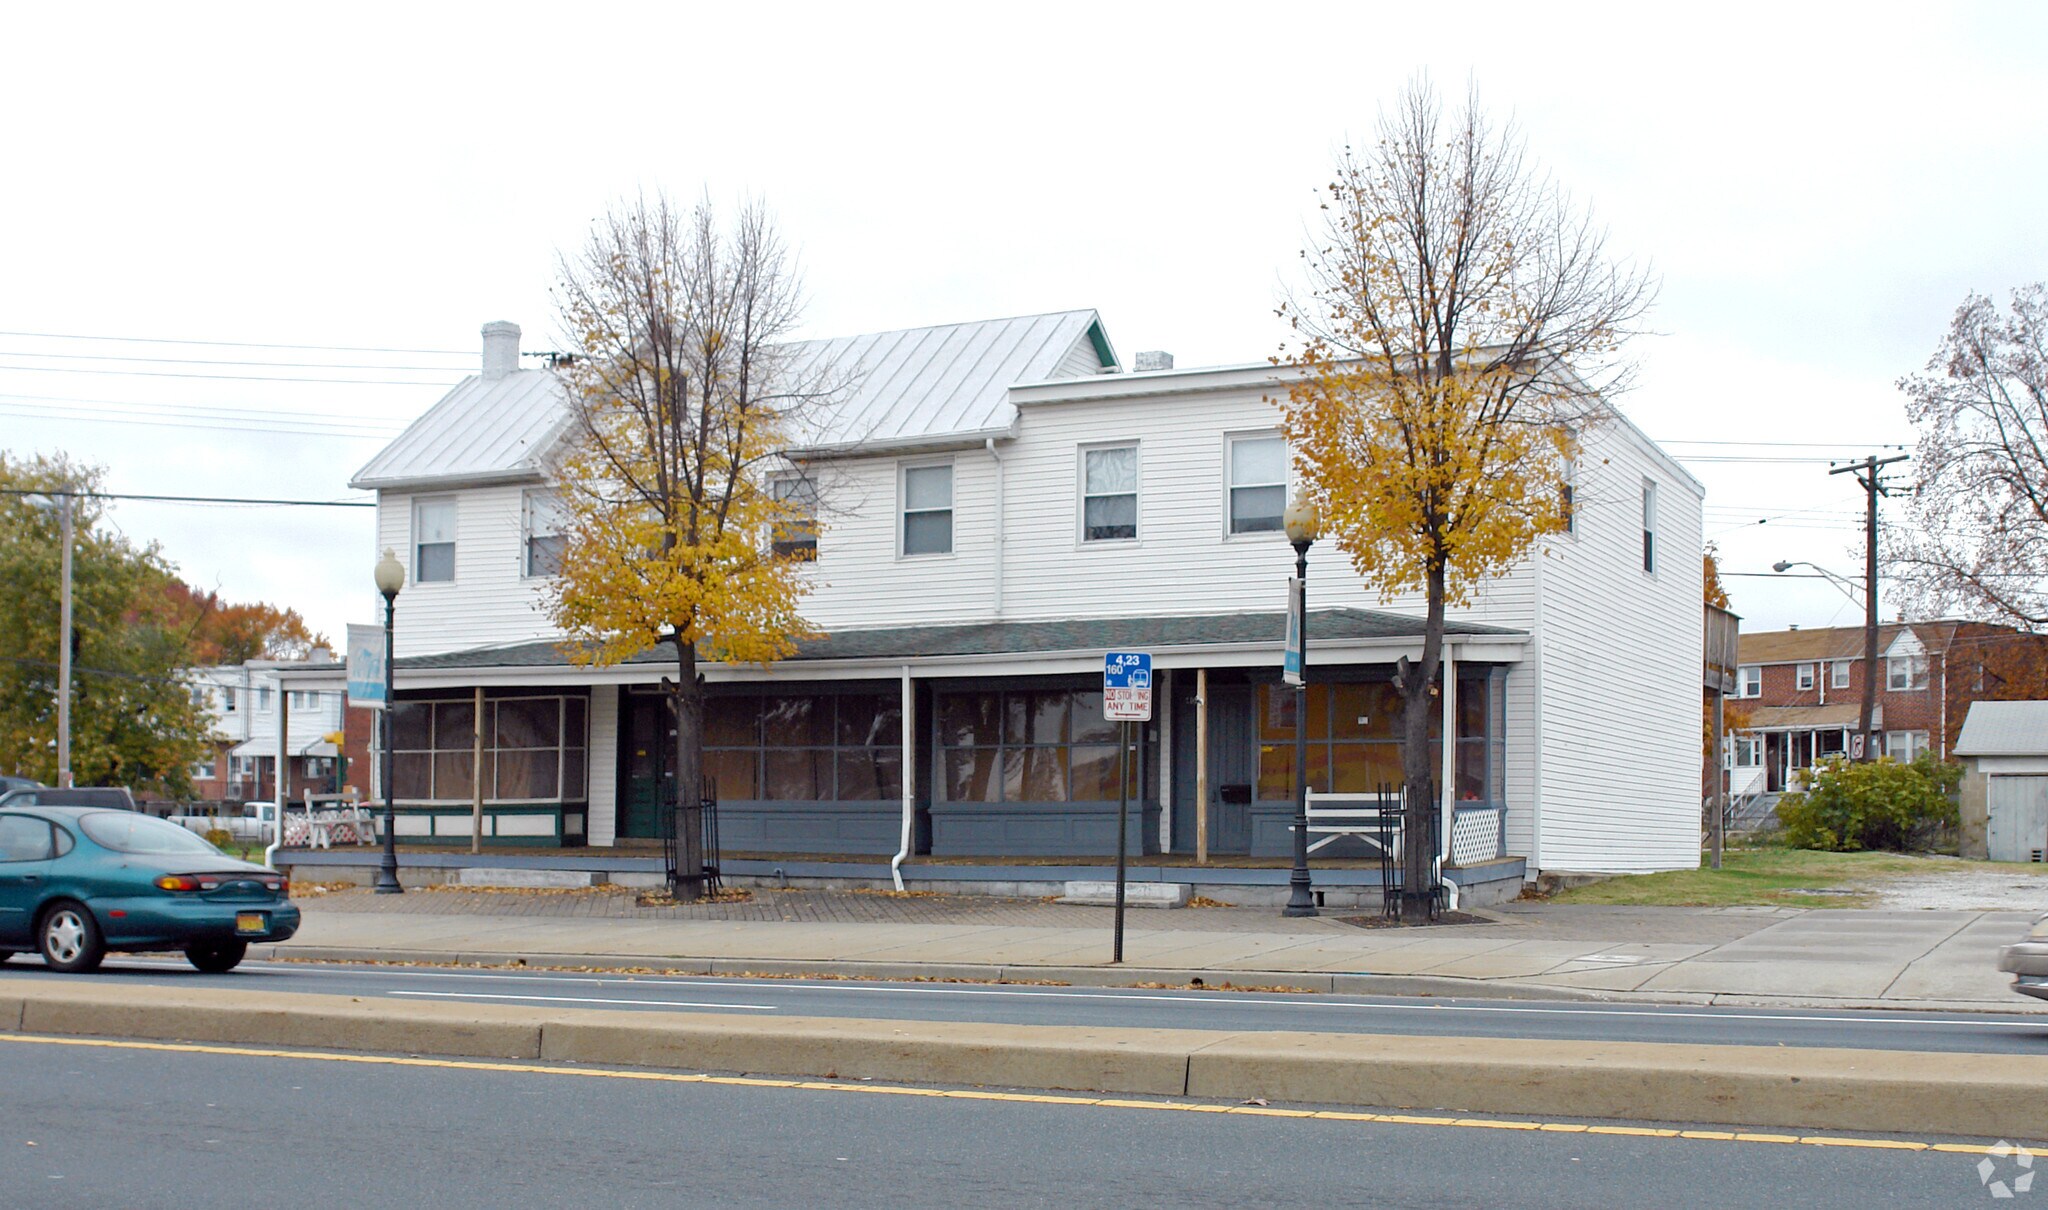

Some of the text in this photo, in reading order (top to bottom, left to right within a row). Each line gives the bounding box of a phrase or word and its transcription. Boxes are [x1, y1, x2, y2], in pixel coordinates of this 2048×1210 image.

[1115, 655, 1140, 666] 4,23
[1106, 665, 1123, 674] 160
[1107, 702, 1148, 711] ANY TIME
